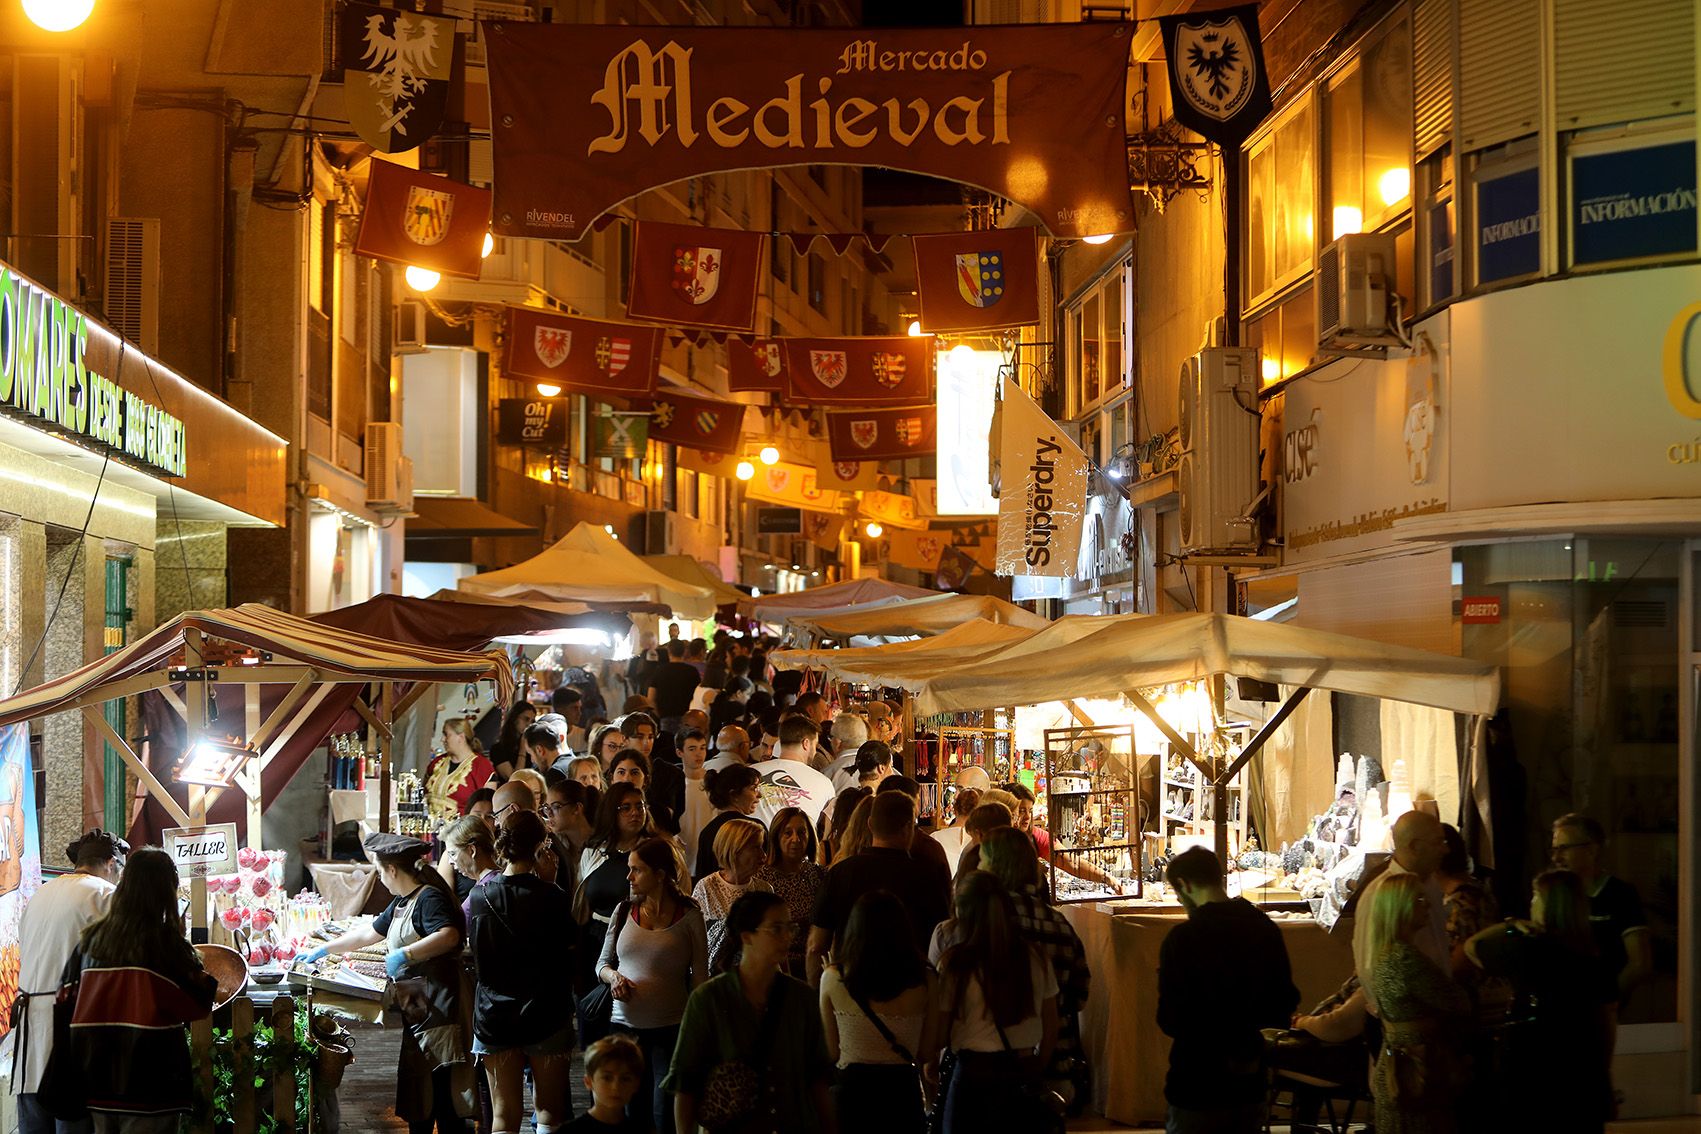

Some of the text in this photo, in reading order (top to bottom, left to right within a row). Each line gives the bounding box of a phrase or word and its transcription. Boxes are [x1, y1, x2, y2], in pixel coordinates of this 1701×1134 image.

[836, 39, 988, 74] Mercado
[588, 38, 1012, 158] Medieval
[526, 208, 575, 223] RIVENDEL
[90, 371, 123, 450] DESDE
[524, 402, 545, 416] Oh
[524, 416, 545, 429] my
[1464, 604, 1500, 617] ABIERTO
[175, 841, 225, 858] TALLER
